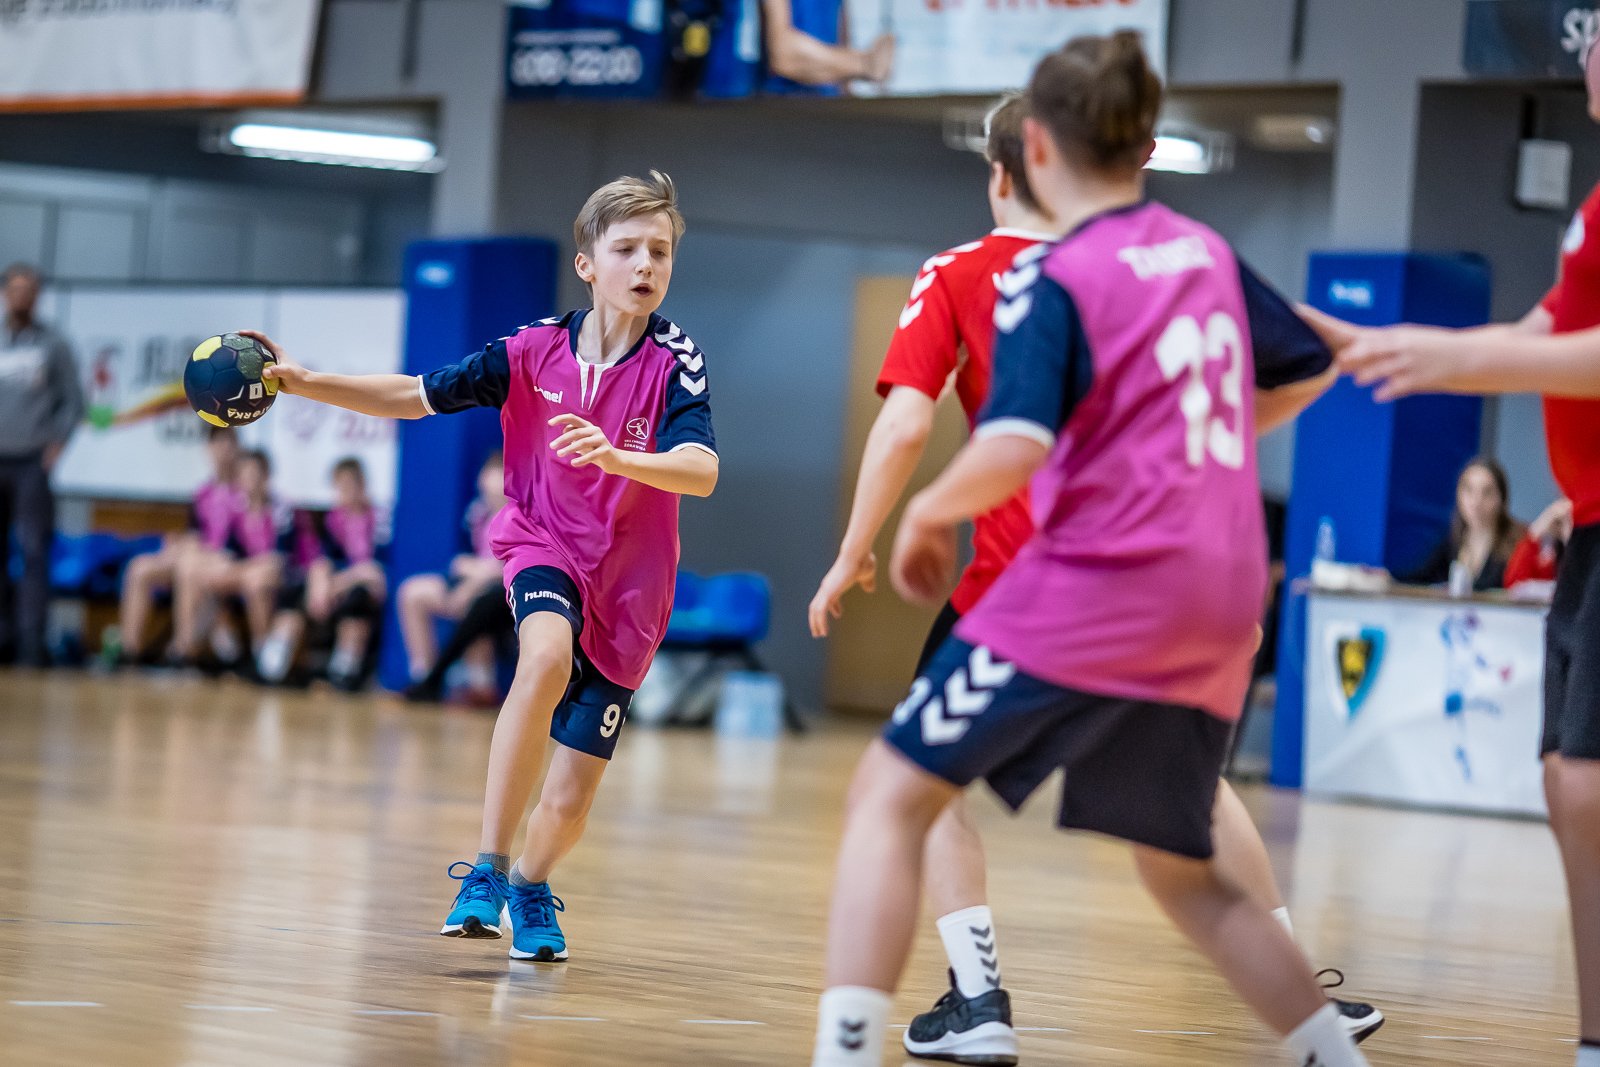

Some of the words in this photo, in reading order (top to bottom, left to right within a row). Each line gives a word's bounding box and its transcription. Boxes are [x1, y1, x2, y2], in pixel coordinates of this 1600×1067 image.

[1154, 313, 1245, 470] 13
[524, 590, 571, 610] hummel
[600, 704, 621, 738] 9
